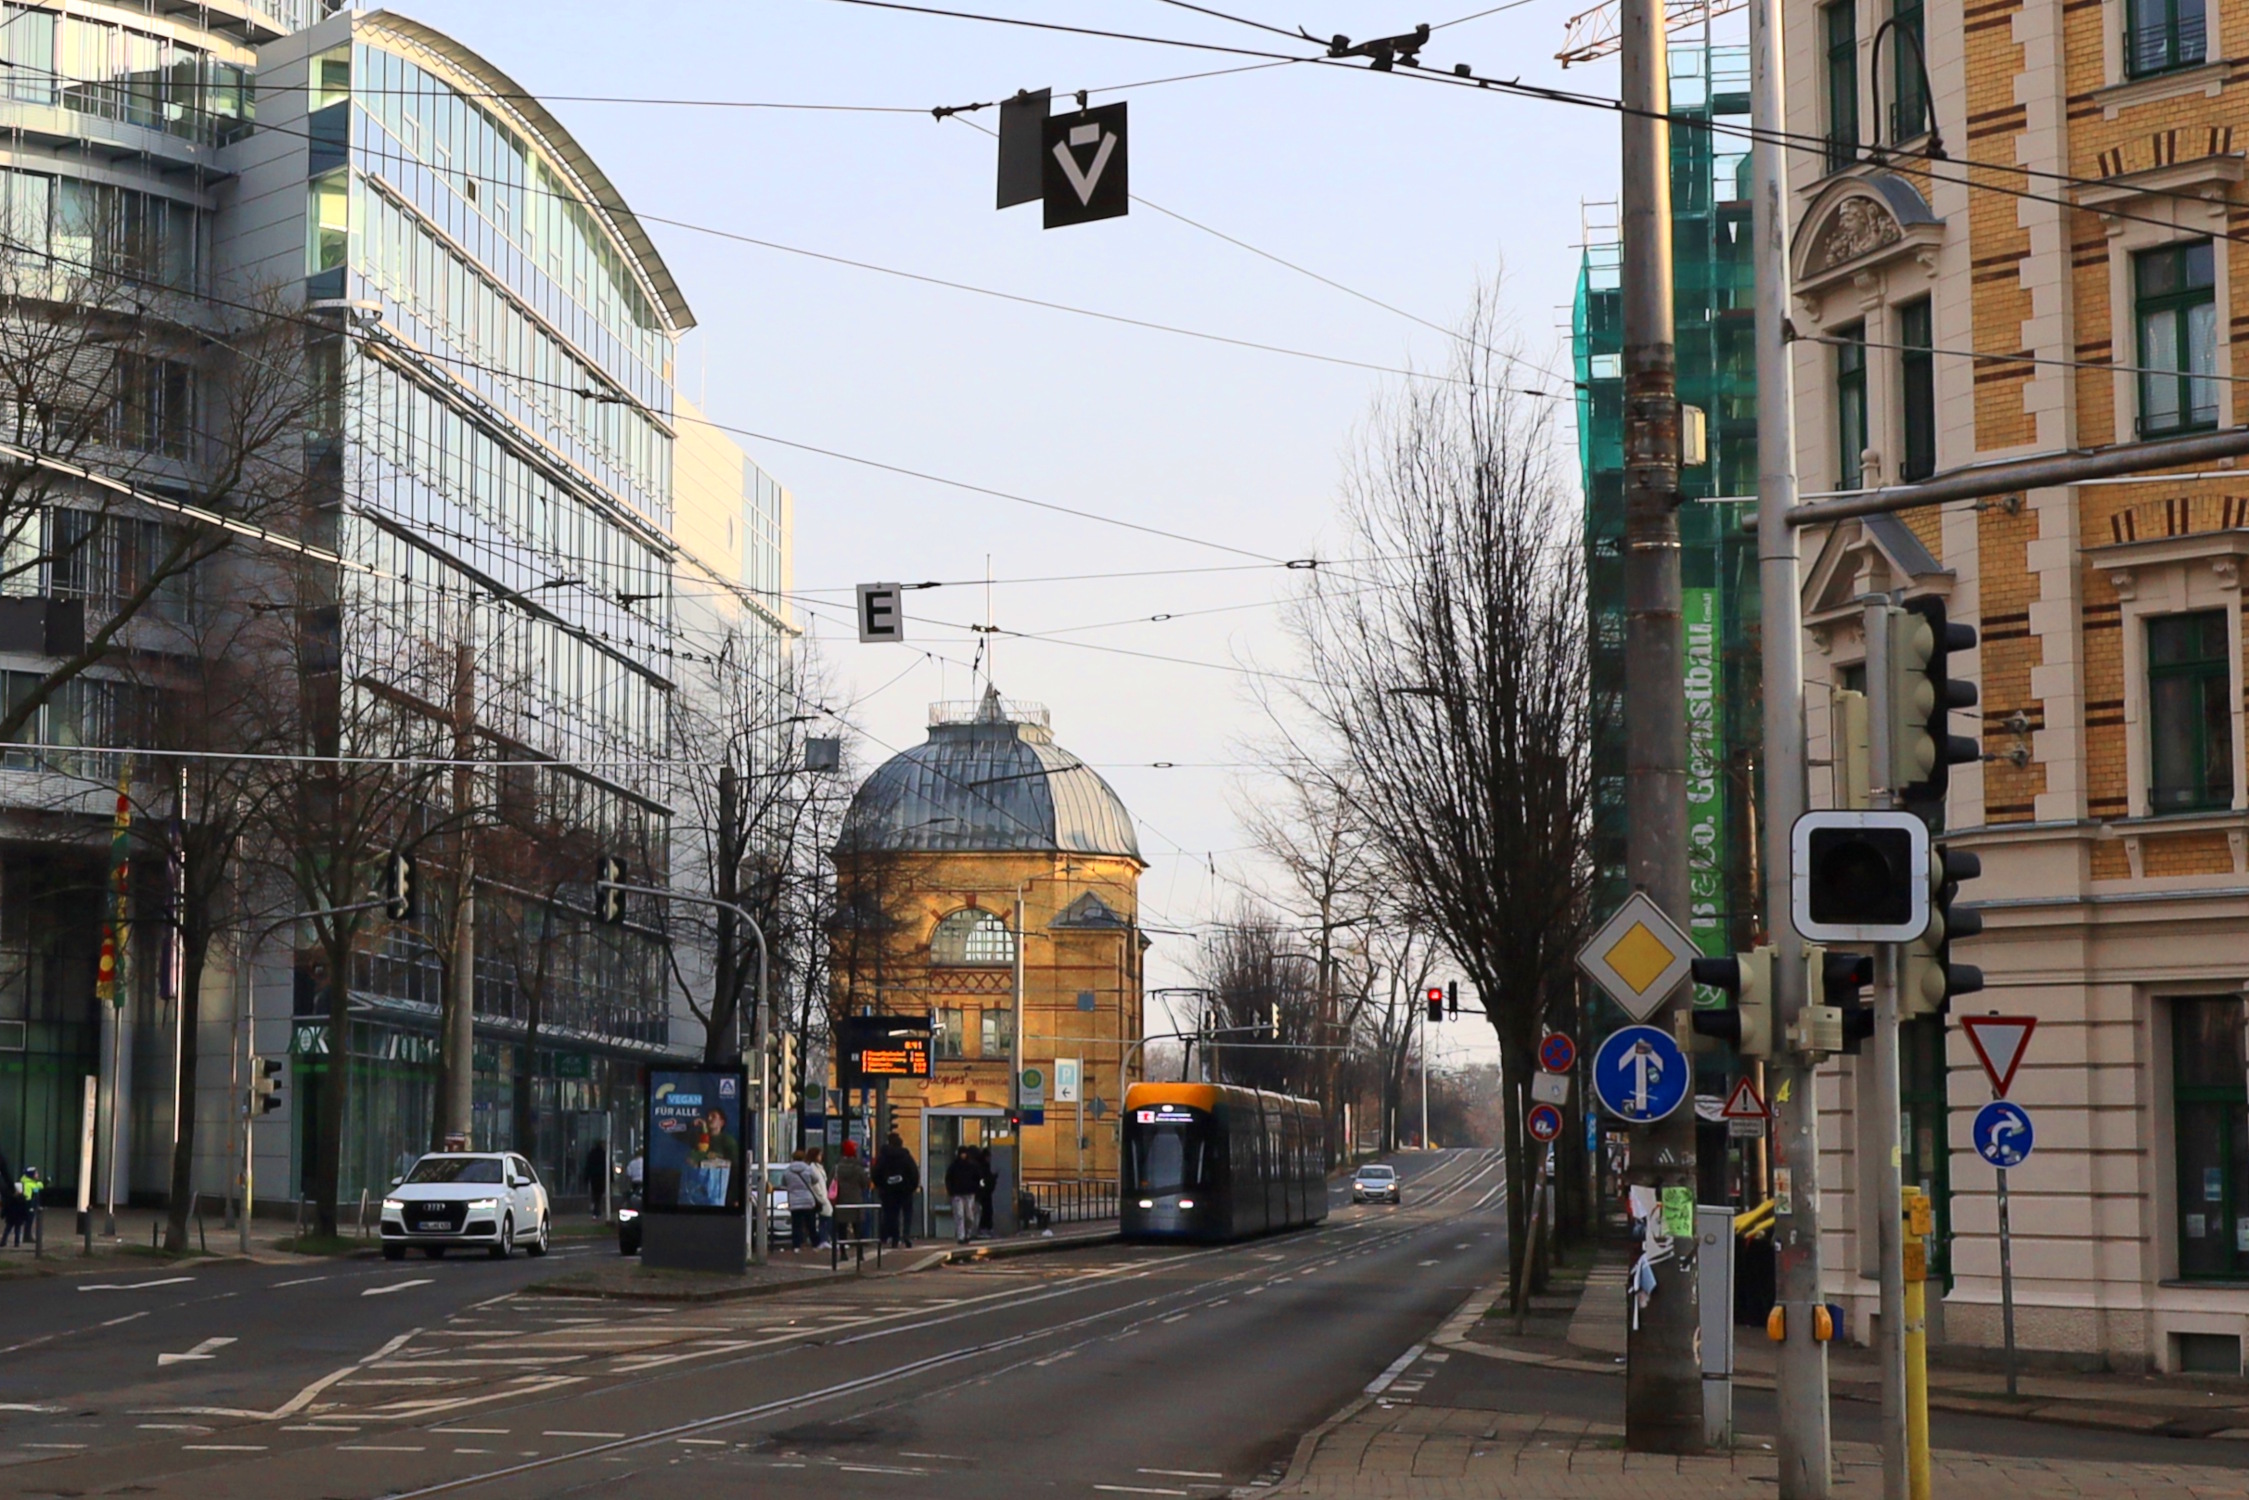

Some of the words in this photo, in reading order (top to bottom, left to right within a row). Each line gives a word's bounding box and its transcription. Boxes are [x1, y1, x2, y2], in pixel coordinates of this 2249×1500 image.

[865, 591, 895, 634] E
[1062, 1069, 1071, 1081] P
[668, 1095, 702, 1104] VEGAN
[654, 1106, 674, 1116] FÜR
[675, 1107, 701, 1117] ALLE.
